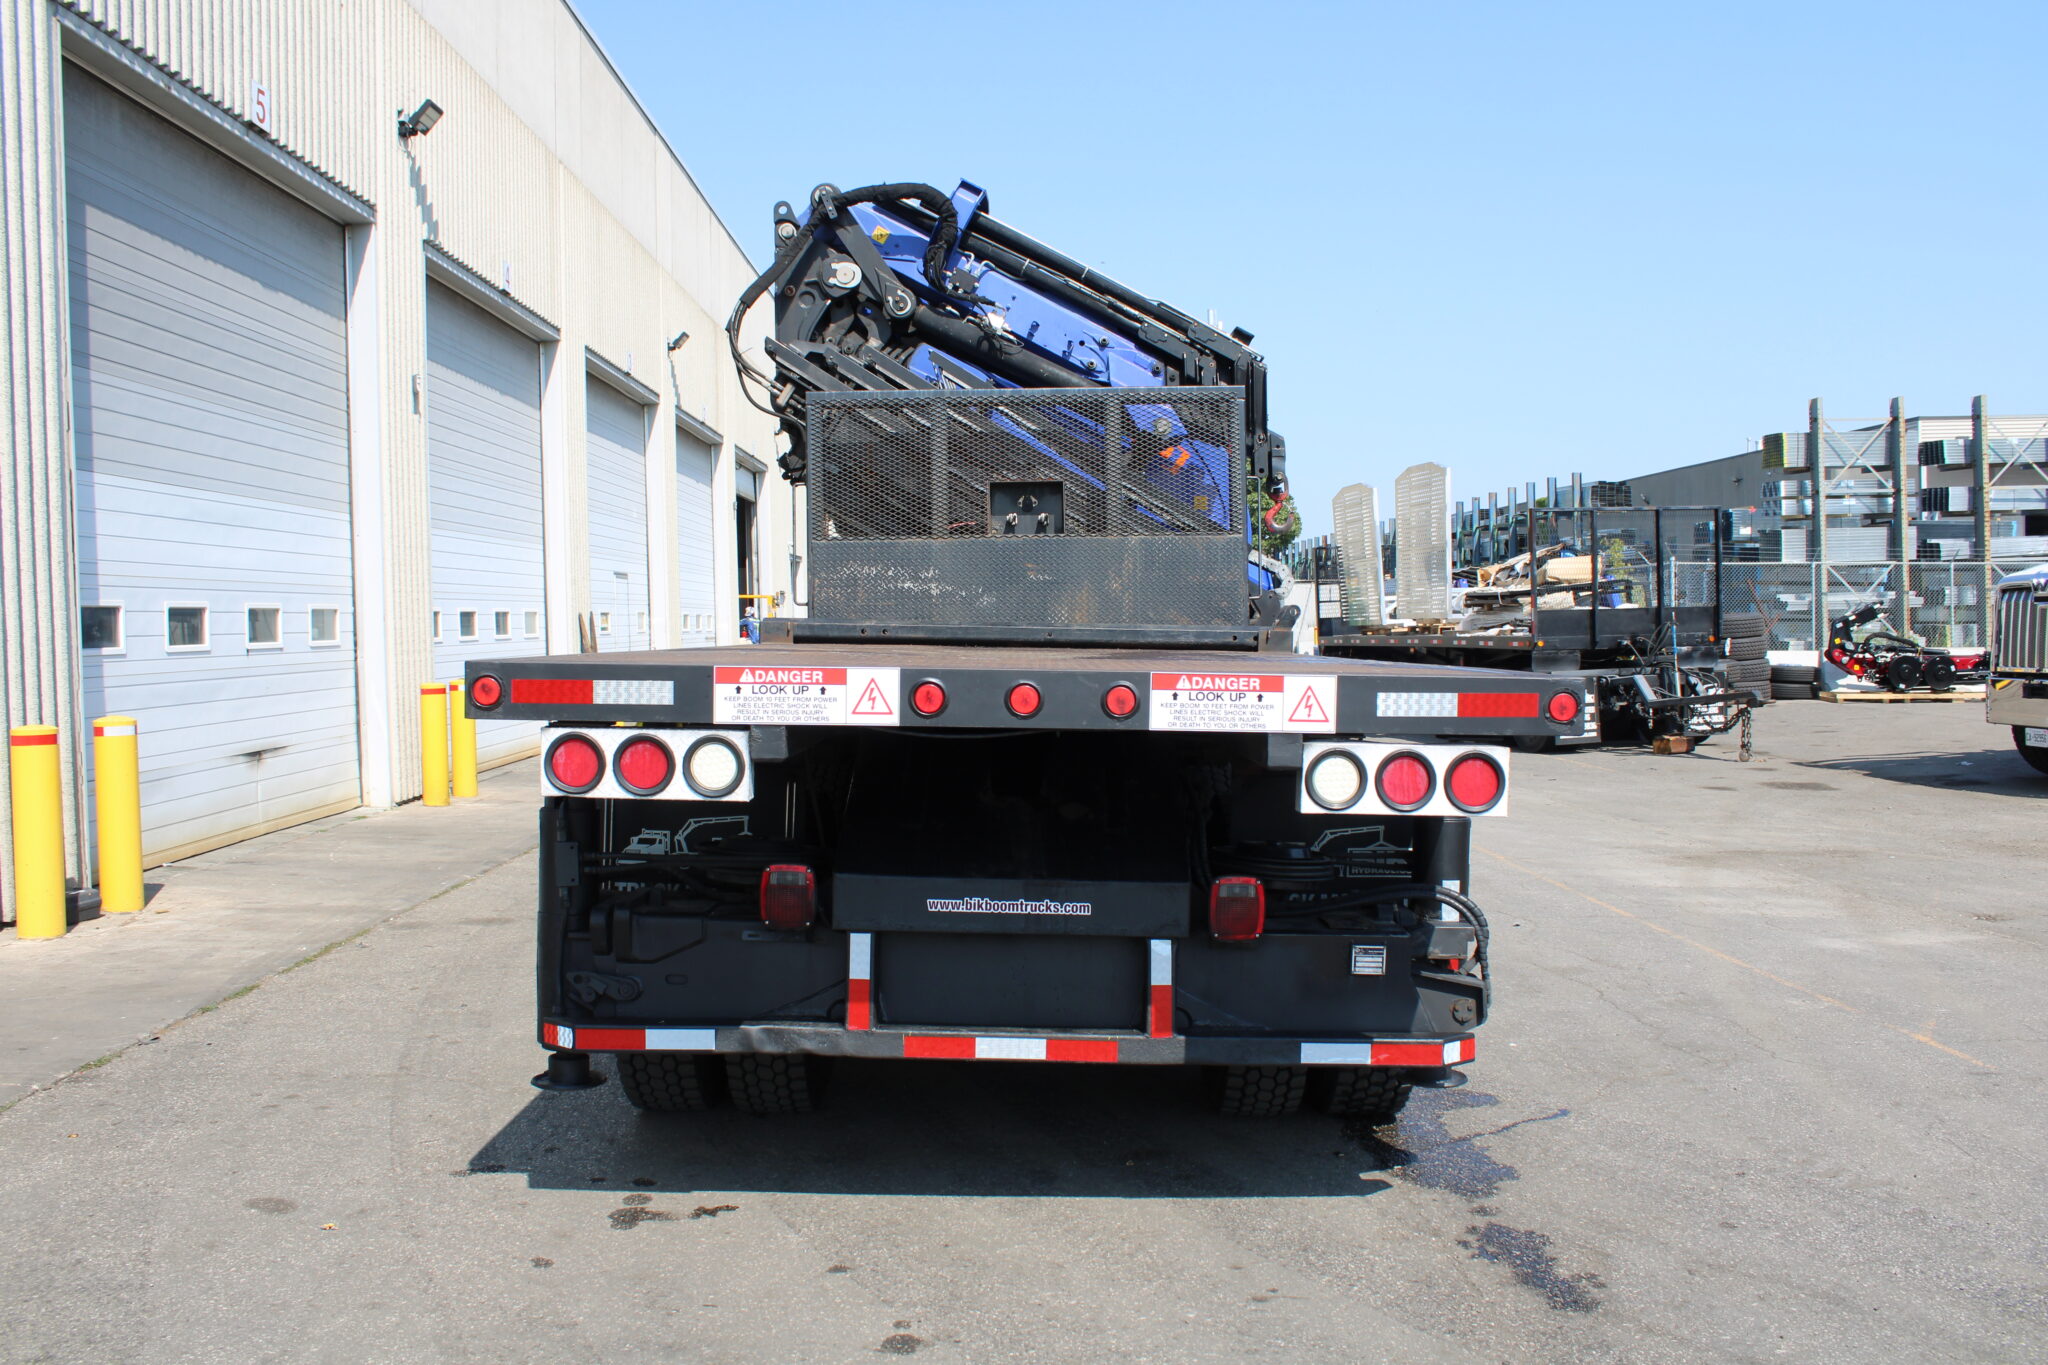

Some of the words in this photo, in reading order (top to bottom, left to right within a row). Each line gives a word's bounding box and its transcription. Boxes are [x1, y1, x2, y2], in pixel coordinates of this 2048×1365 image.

[256, 87, 266, 124] 5
[755, 671, 823, 683] DANGER
[1192, 677, 1260, 690] DANGER
[752, 686, 787, 694] LOOK
[792, 686, 809, 694] UP
[1189, 692, 1224, 701] LOOK
[1229, 692, 1246, 701] UP
[927, 898, 1091, 915] www.bikboomtrucks.com
